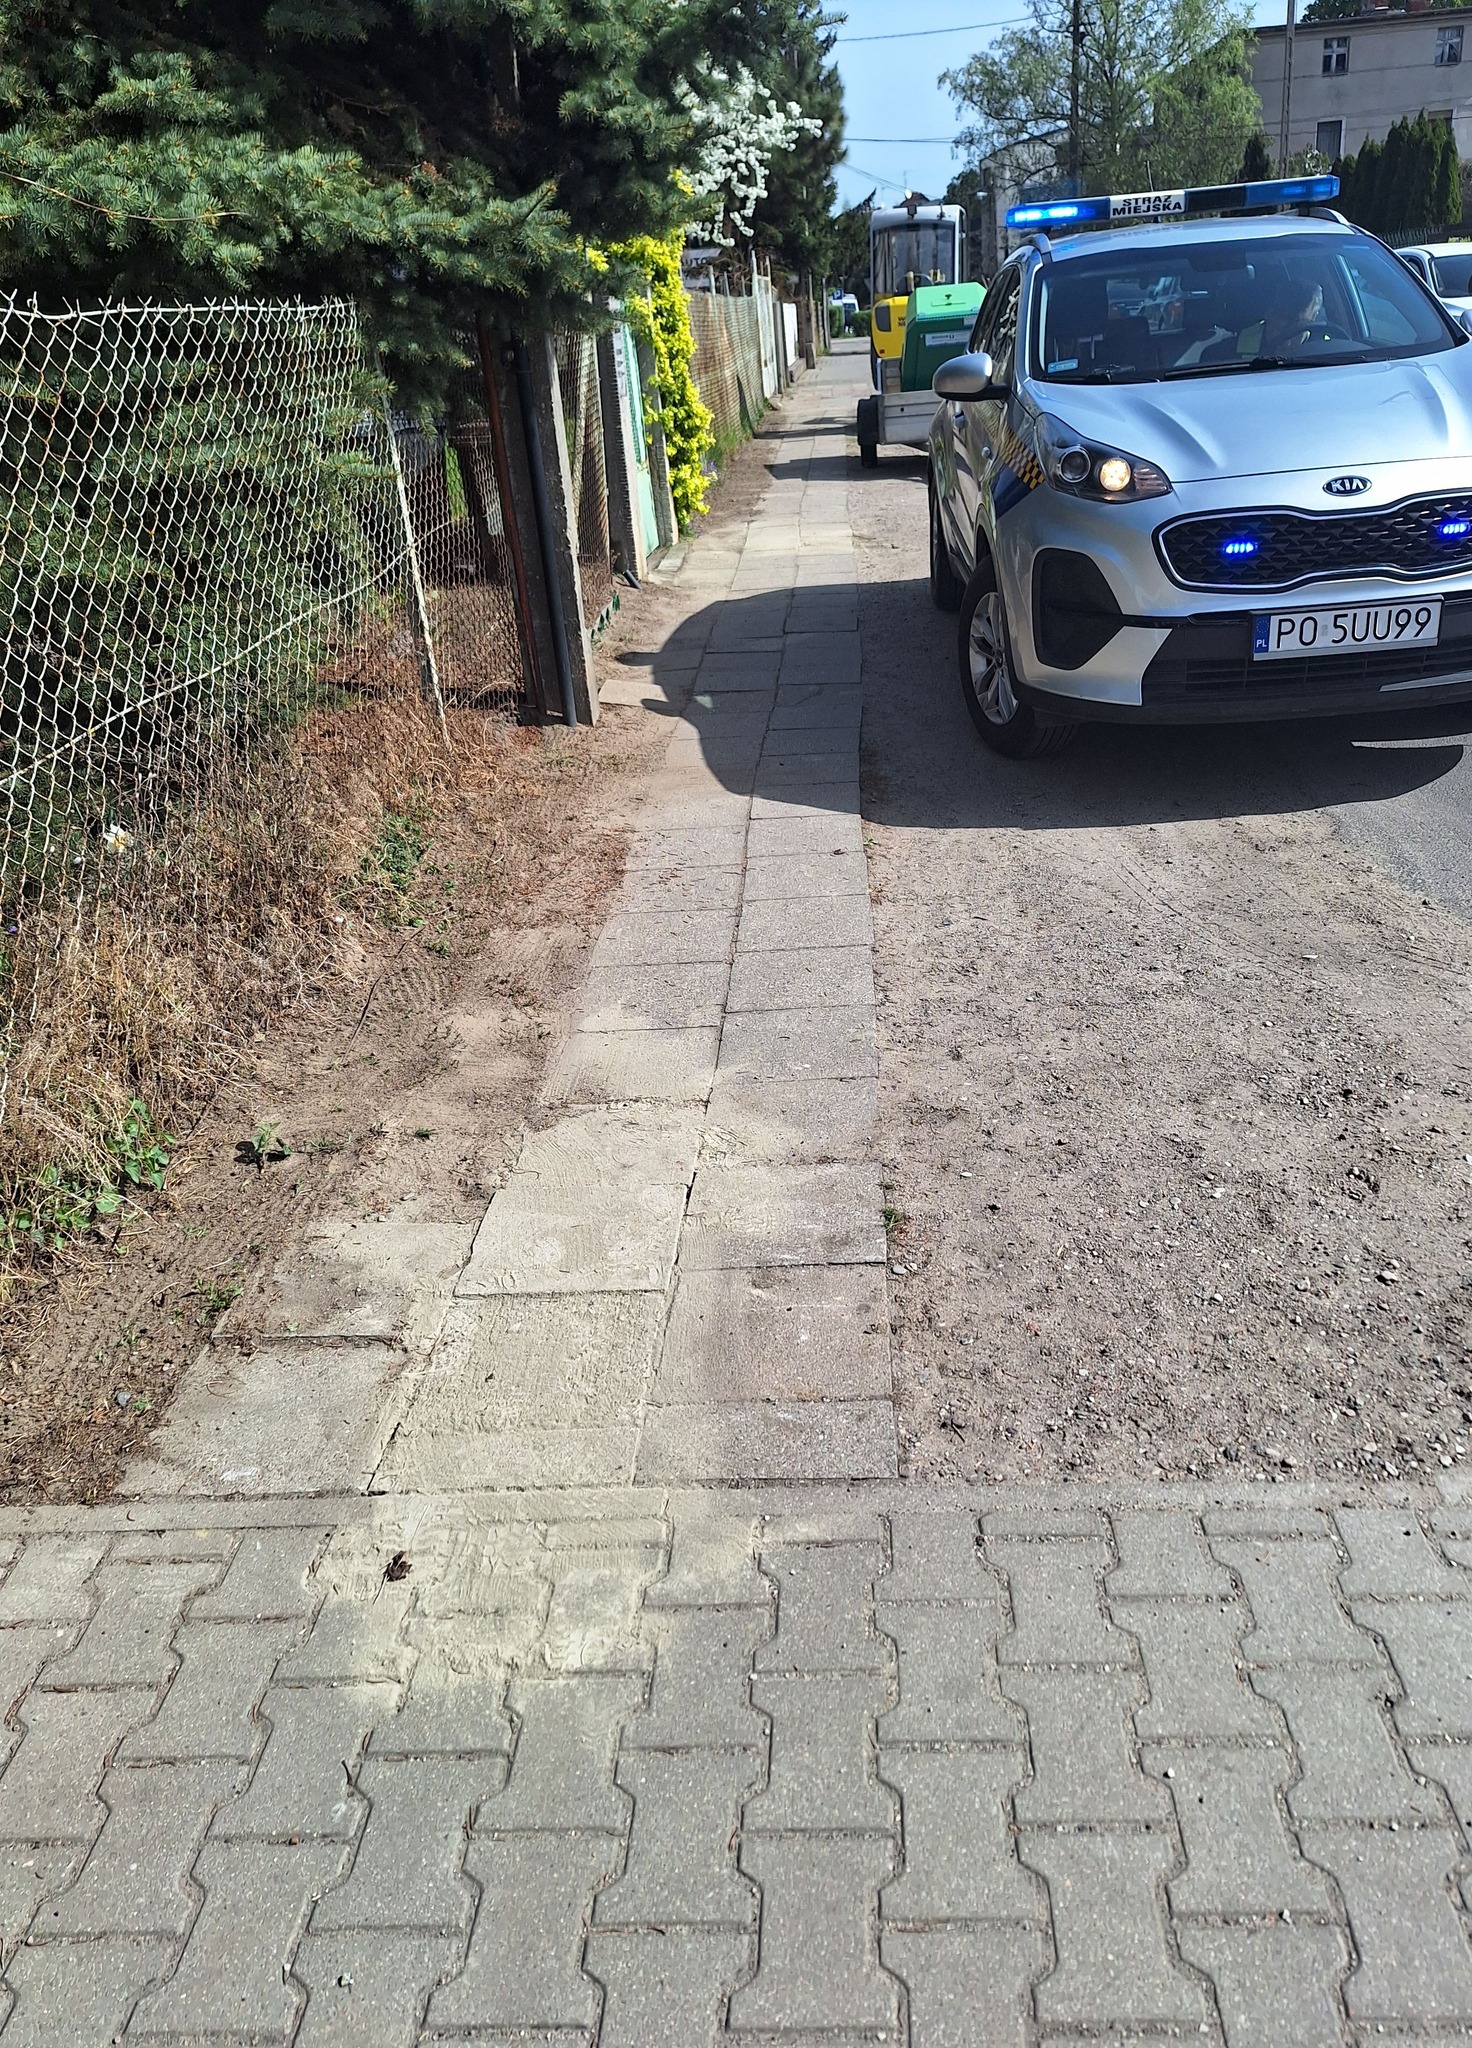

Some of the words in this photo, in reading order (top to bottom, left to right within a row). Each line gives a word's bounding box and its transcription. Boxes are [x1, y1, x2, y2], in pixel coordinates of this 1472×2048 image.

[1112, 202, 1182, 216] MIEJSKA
[1330, 478, 1365, 492] KIA
[1276, 616, 1318, 648] PO
[1331, 607, 1432, 643] 5UU99
[1256, 639, 1267, 648] PL
